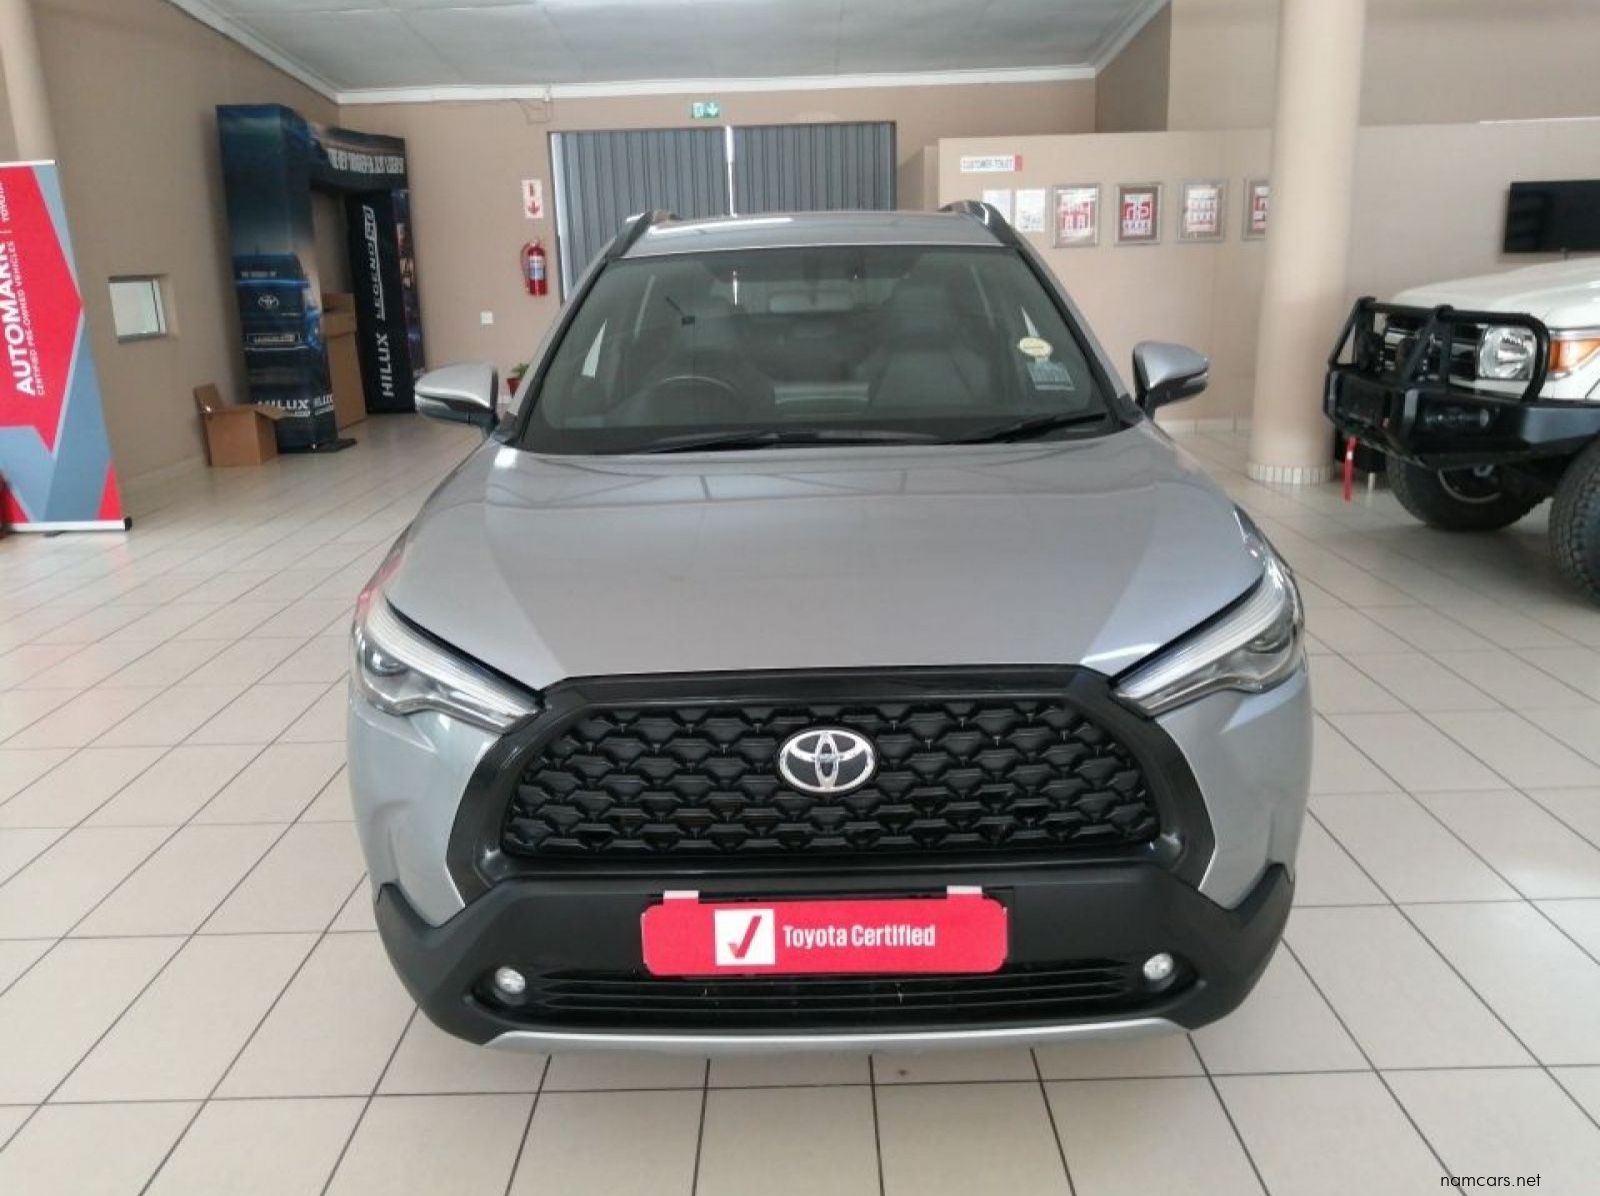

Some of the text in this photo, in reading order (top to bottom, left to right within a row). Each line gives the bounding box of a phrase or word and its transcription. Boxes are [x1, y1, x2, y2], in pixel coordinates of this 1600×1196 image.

[7, 240, 45, 396] CERTIFIED PRE-OWNED VEHICLES
[376, 332, 394, 397] HILUX
[782, 924, 936, 949] Toyota Certified
